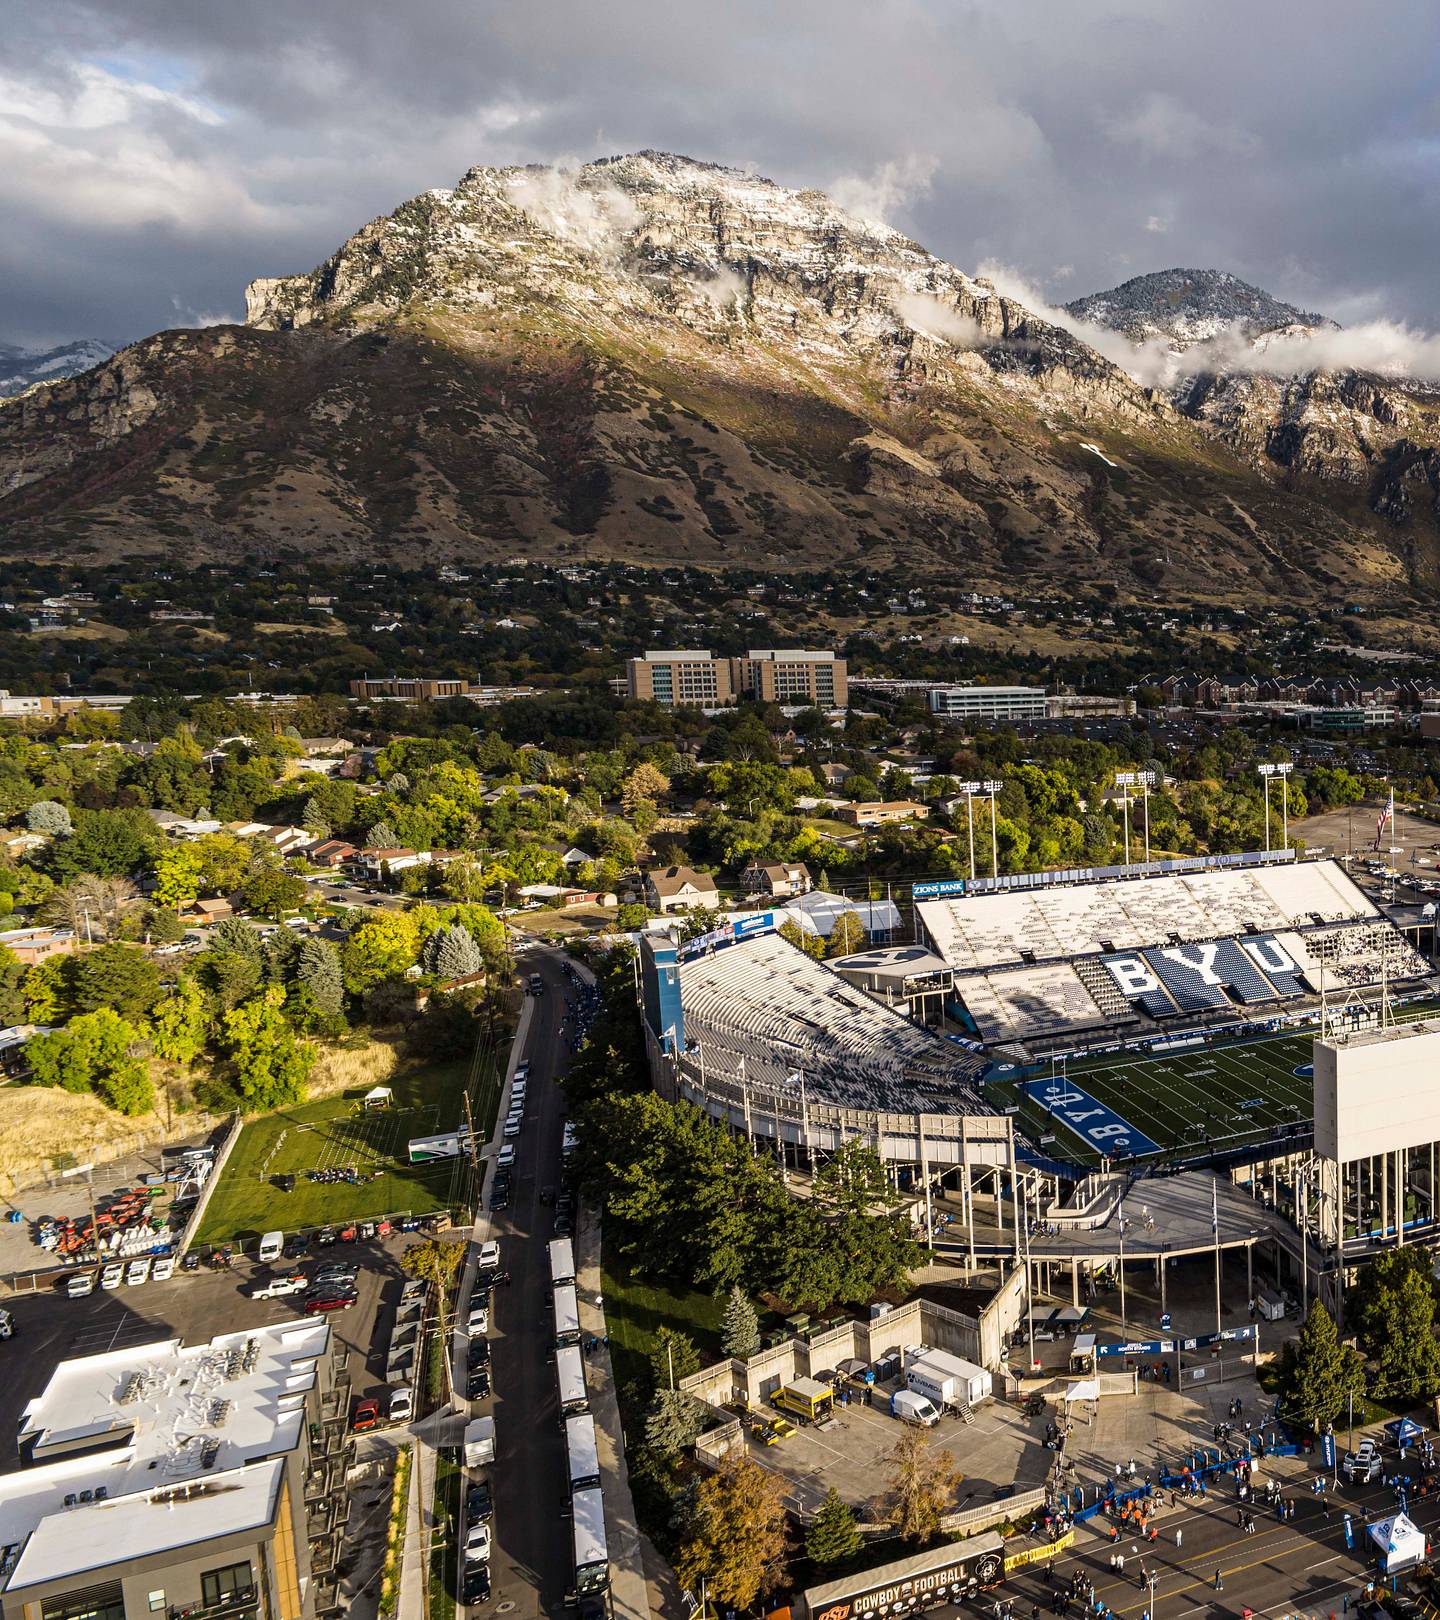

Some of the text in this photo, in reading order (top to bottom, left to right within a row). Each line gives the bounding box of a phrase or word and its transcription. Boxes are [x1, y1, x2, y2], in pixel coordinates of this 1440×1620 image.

[914, 882, 963, 894] ZIONS BANK
[1105, 943, 1297, 995] BYU
[854, 1564, 967, 1613] COWBOY FOOTBALL
